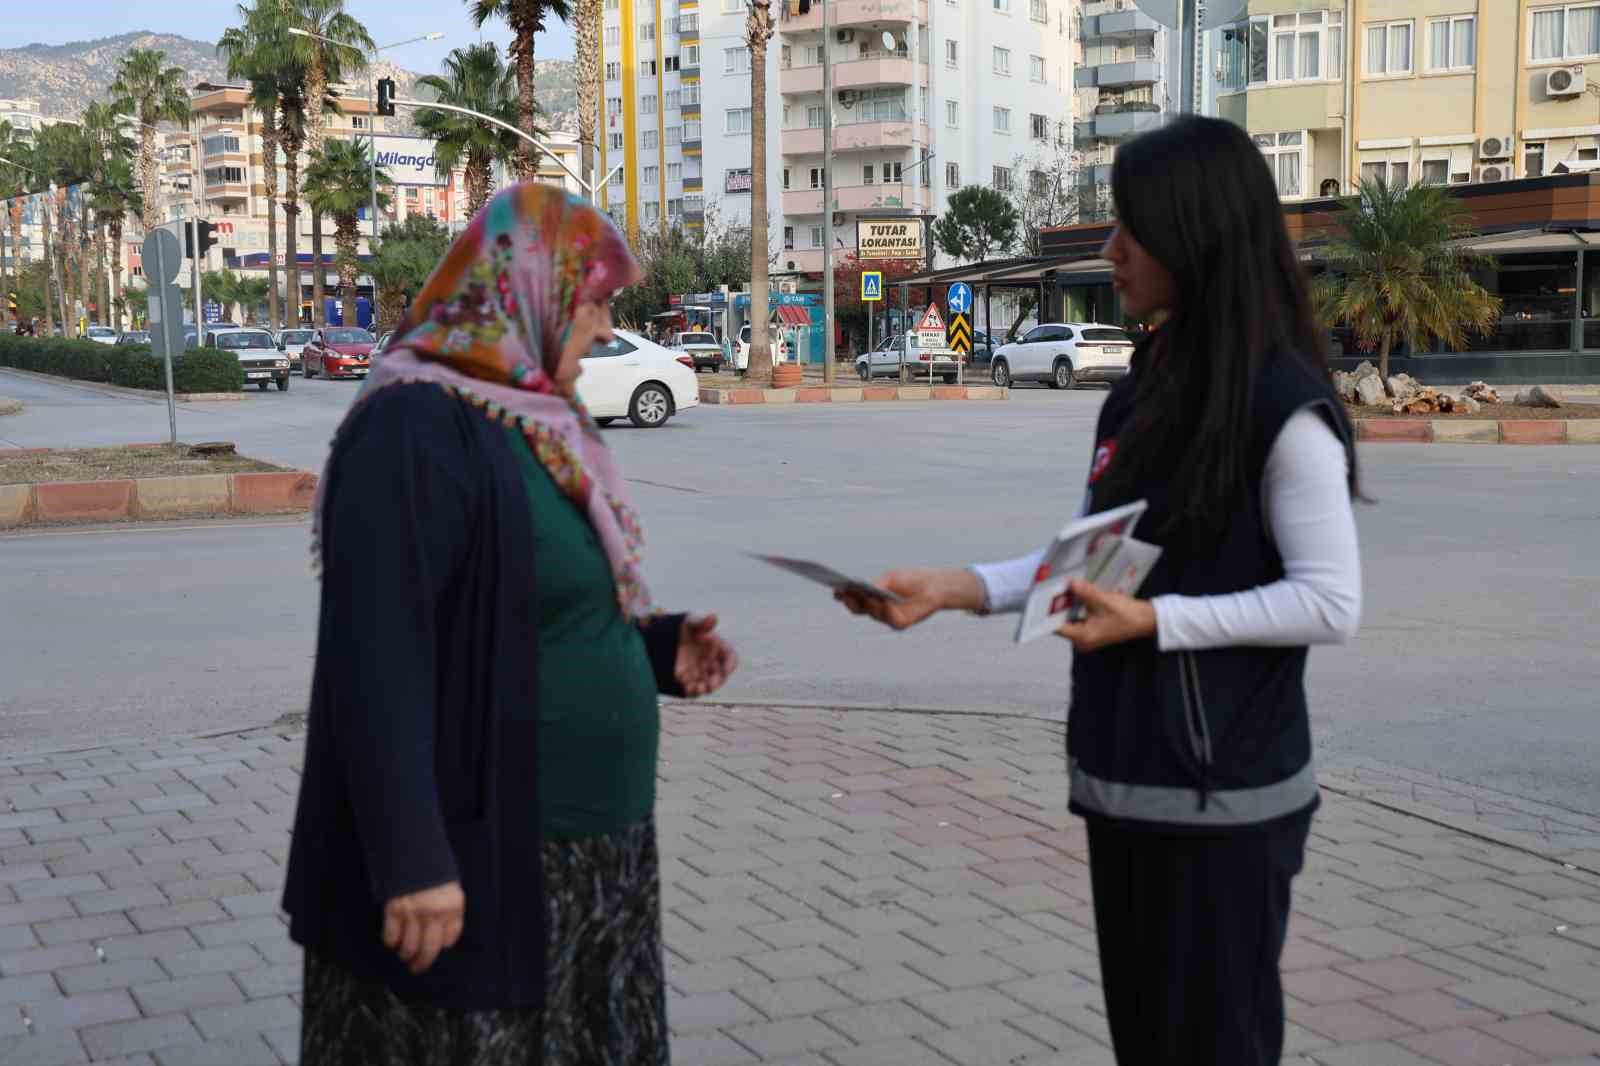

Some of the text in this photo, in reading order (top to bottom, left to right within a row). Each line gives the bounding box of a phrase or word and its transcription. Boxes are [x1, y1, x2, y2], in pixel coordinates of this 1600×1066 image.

[376, 151, 434, 171] Milanga
[871, 225, 906, 236] TUTAR
[861, 238, 916, 248] LOKANTASI
